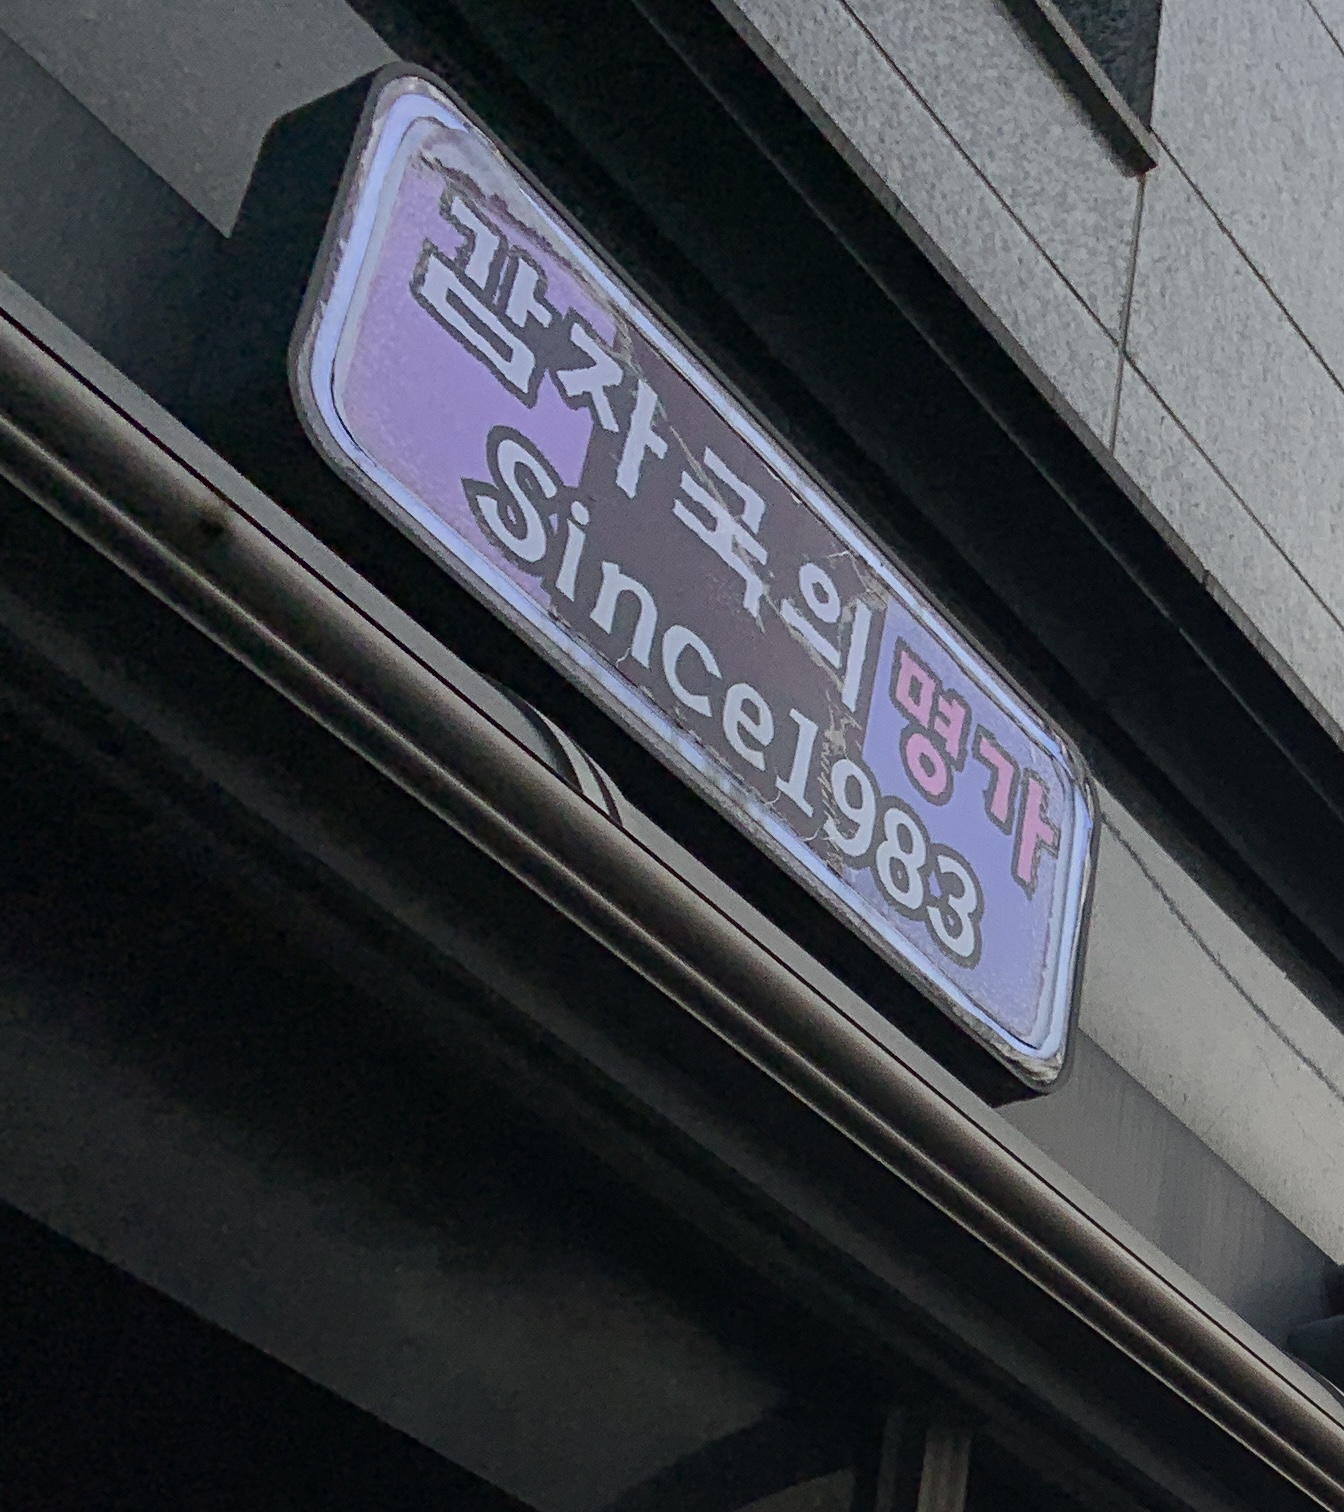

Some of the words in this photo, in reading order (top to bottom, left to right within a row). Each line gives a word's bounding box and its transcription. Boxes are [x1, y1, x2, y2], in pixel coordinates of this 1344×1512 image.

[411, 193, 883, 712] 감자국의
[887, 633, 1064, 900] 명가
[460, 424, 986, 970] Since1983
